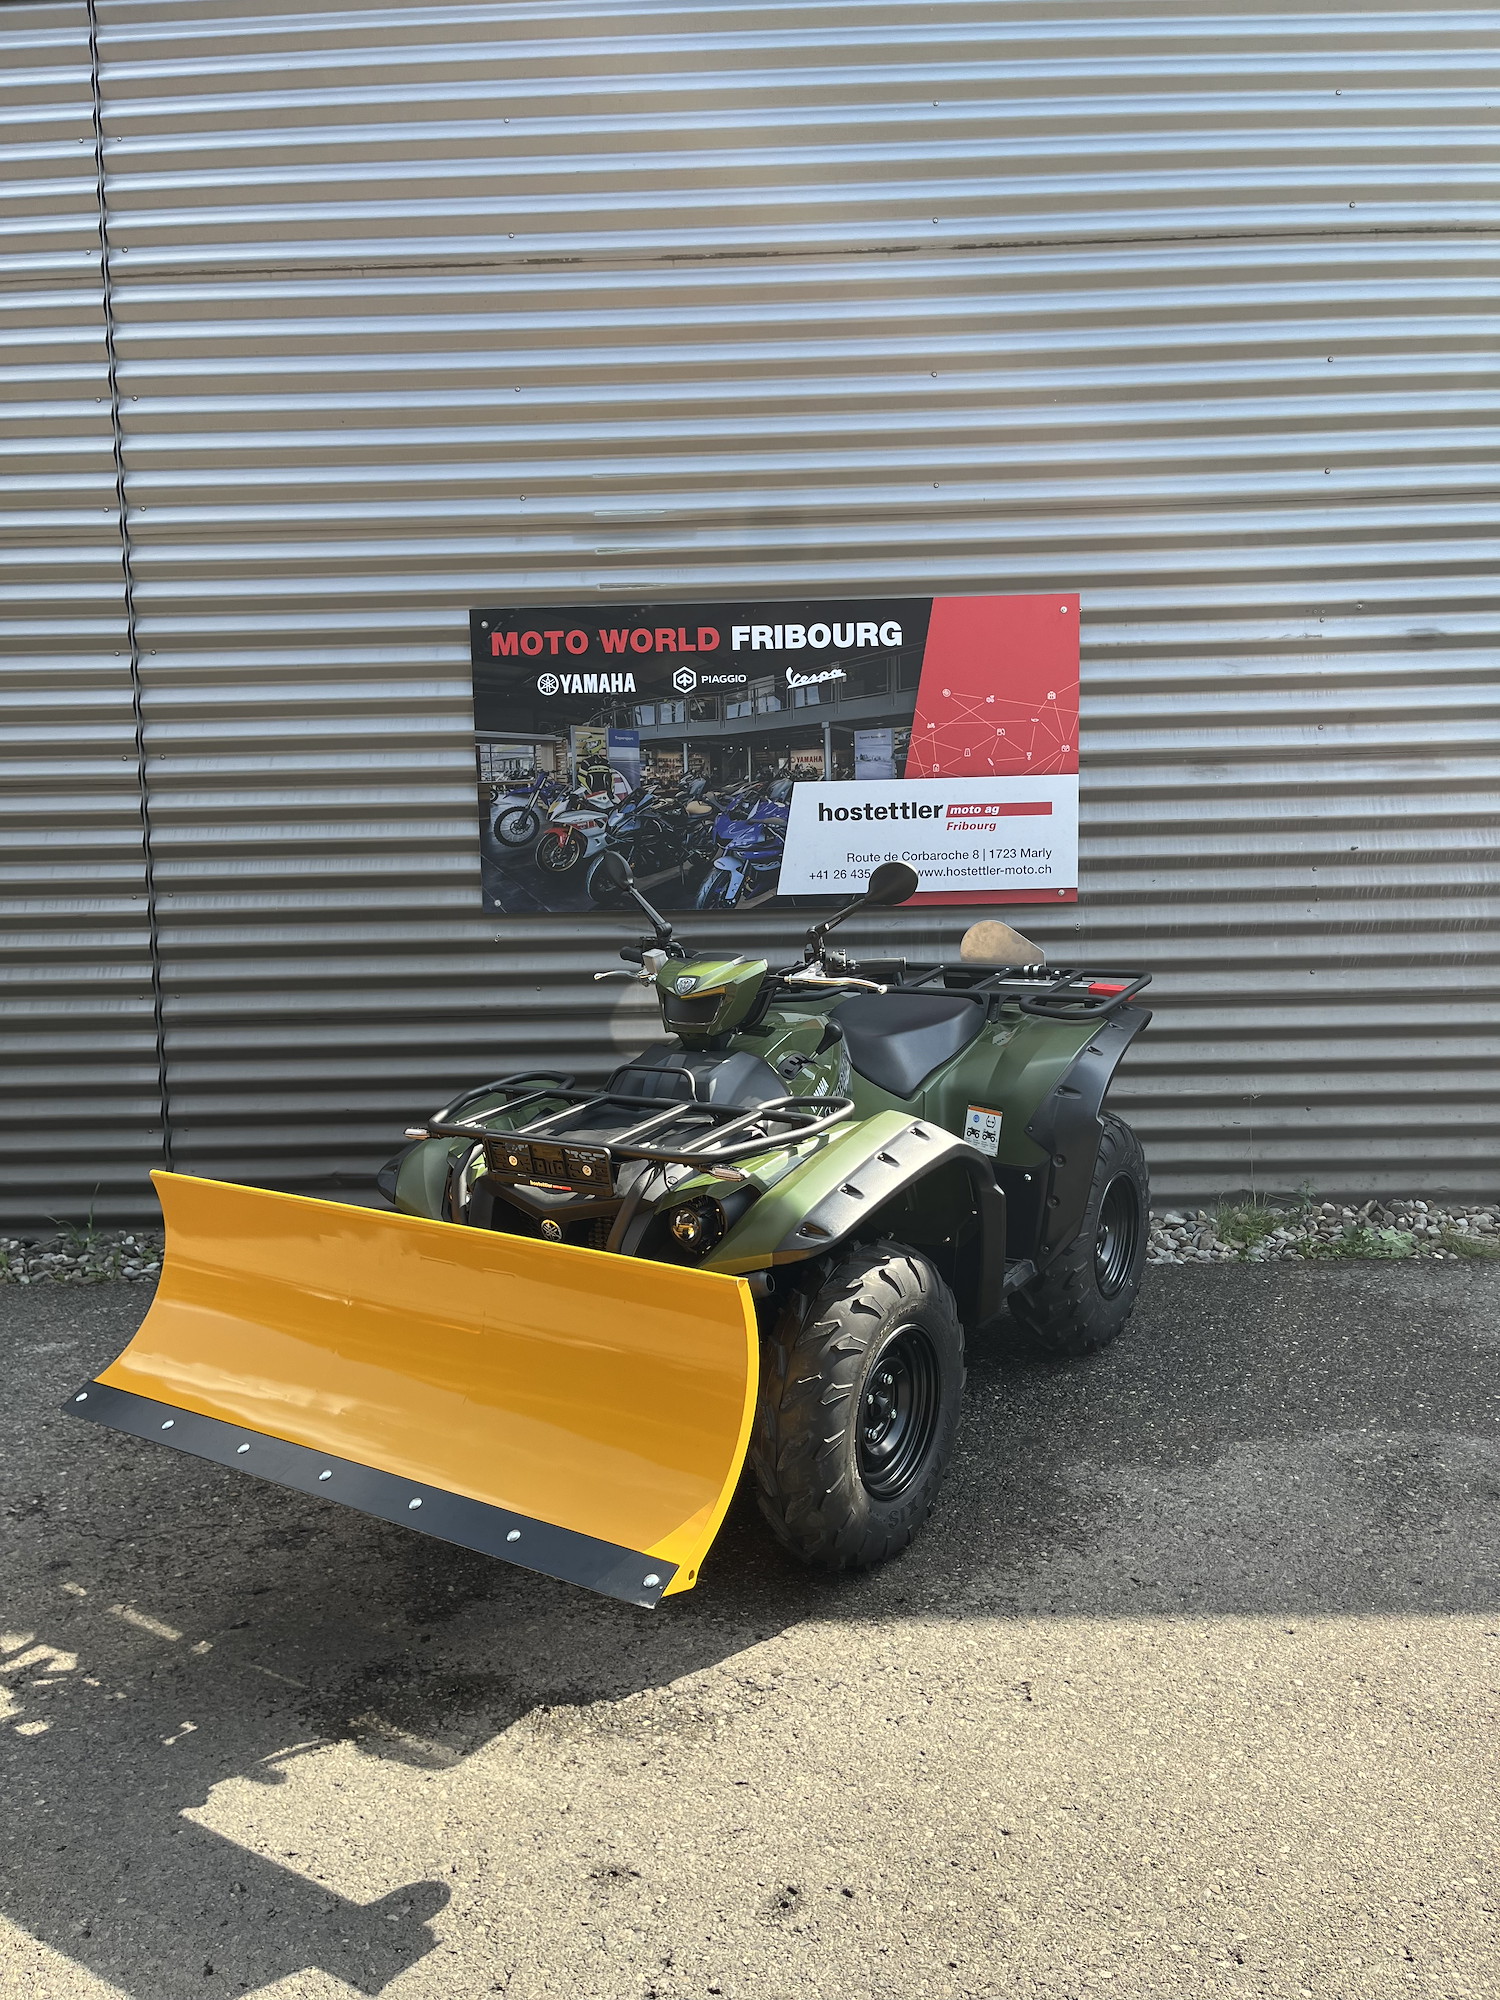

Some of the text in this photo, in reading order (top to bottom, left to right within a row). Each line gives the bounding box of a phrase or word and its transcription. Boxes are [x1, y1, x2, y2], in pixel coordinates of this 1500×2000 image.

[491, 621, 903, 656] MOTO WORLD FRIBOURG
[560, 673, 637, 694] YAMAHA
[701, 674, 747, 685] PIAGGIO
[786, 667, 847, 689] Vespa
[796, 755, 823, 763] YAMAHA
[818, 802, 944, 822] hostettler
[950, 804, 1000, 816] moto ag
[946, 821, 997, 832] Fribourg
[846, 852, 881, 863] Route
[883, 851, 899, 862] de
[901, 850, 969, 861] Corbaroche
[972, 849, 980, 860] 8
[989, 849, 1017, 860] 1723
[1020, 848, 1052, 860] Marly
[809, 870, 829, 880] +41
[833, 869, 847, 880] 26
[850, 868, 871, 879] 435
